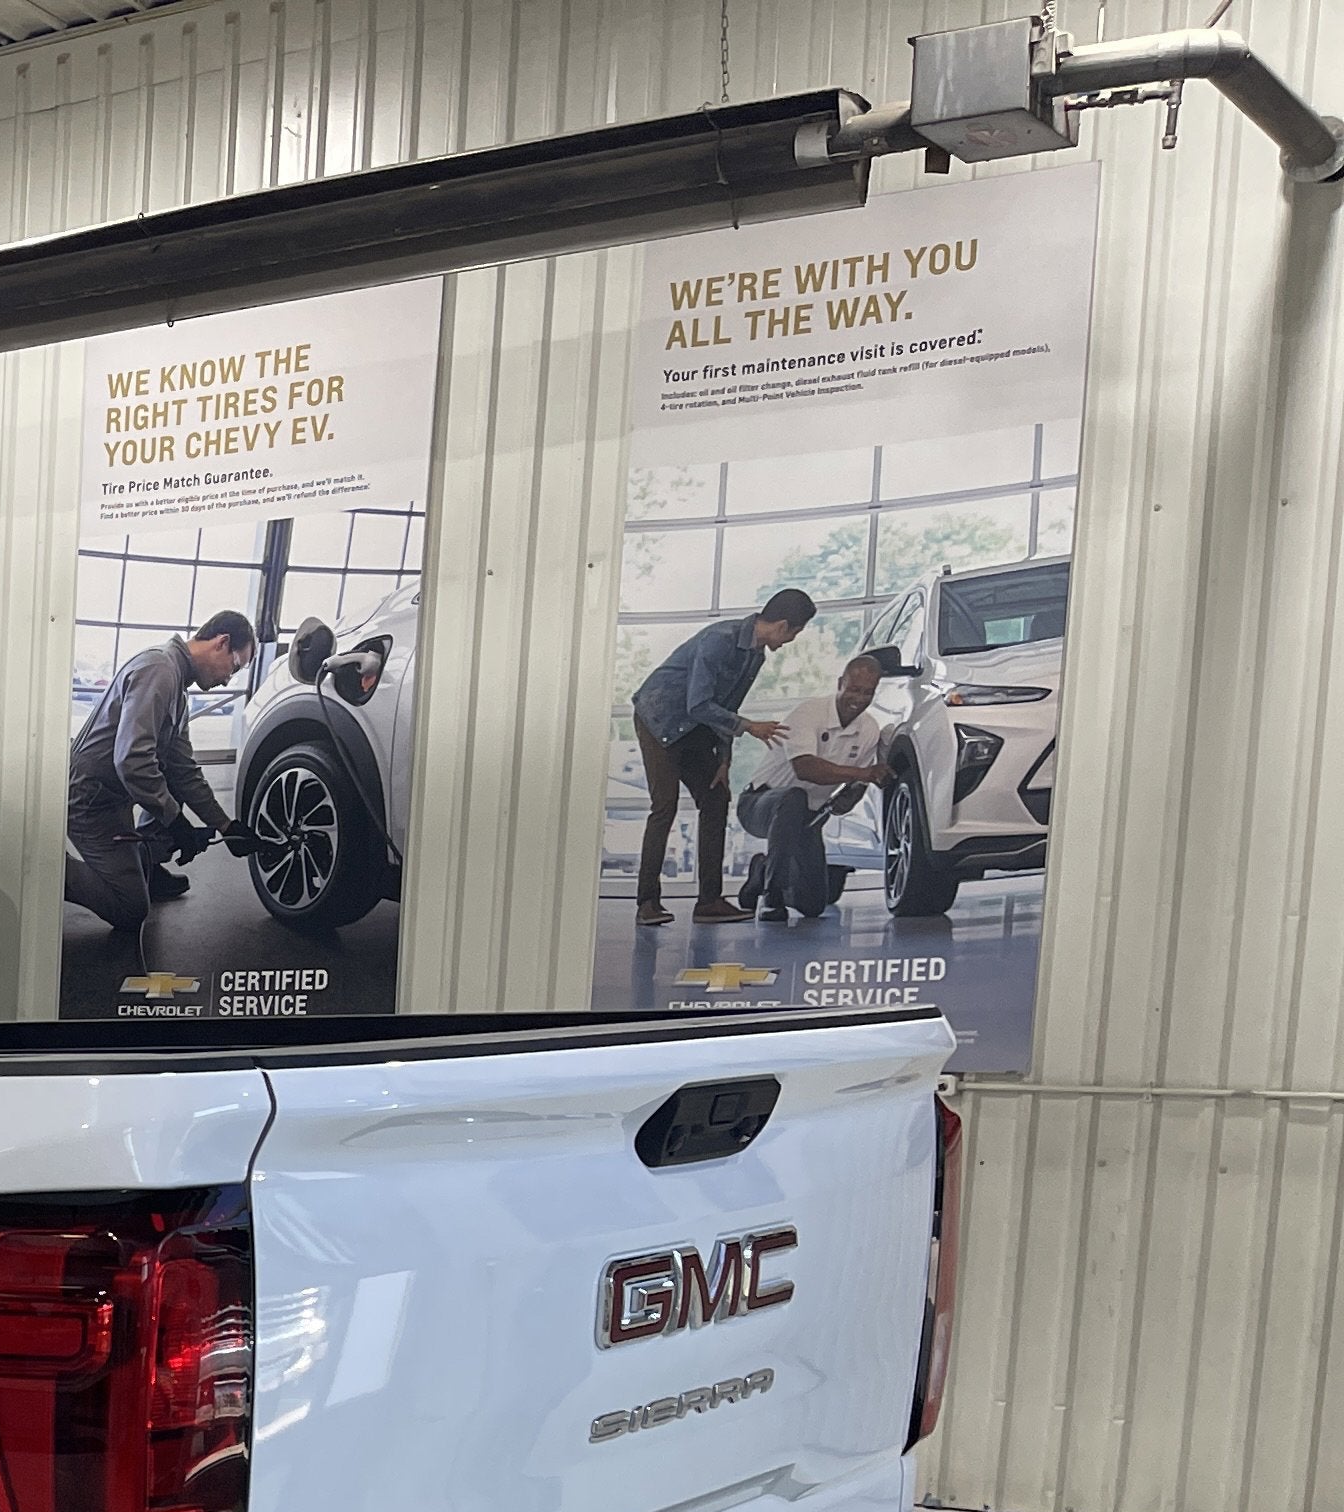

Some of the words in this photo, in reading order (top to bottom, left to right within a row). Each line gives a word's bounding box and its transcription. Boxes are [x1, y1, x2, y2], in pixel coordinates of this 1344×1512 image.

[670, 268, 782, 311] WE'RE
[794, 252, 890, 295] WITH
[903, 238, 978, 279] YOU
[665, 315, 733, 350] ALL
[744, 303, 813, 341] THE
[826, 290, 913, 331] WAY.
[107, 369, 150, 399] WE
[159, 354, 246, 393] KNOW
[255, 343, 311, 378] THE
[663, 369, 698, 383] Your
[702, 364, 737, 380] first
[742, 352, 846, 375] maintenance
[850, 344, 886, 362] visit
[890, 341, 904, 357] is
[710, 387, 725, 395] and
[821, 372, 855, 383] exhaust
[878, 365, 897, 376] tank
[921, 360, 938, 371] (for
[105, 399, 188, 434] RIGHT
[196, 385, 278, 422] TIRES
[288, 375, 344, 410] FOR
[721, 397, 736, 406] and
[103, 435, 175, 468] YOUR
[185, 420, 283, 459] CHEVY
[291, 413, 334, 446] EV.
[102, 483, 124, 495] Tire
[128, 480, 159, 493] Price
[163, 474, 200, 490] Match
[204, 467, 273, 485] Guarantee.
[202, 493, 219, 502] price
[302, 480, 314, 489] and
[141, 509, 158, 518] price
[190, 504, 205, 513] days
[262, 496, 275, 504] and
[293, 491, 317, 500] refund
[318, 488, 330, 496] the
[220, 969, 328, 992] CERTIFIED
[803, 956, 947, 984] CERTIFIED
[118, 1004, 203, 1017] CHEVROLET
[218, 994, 308, 1017] SERVICE
[594, 1224, 798, 1351] GMC
[588, 1367, 775, 1444] SIERRA
